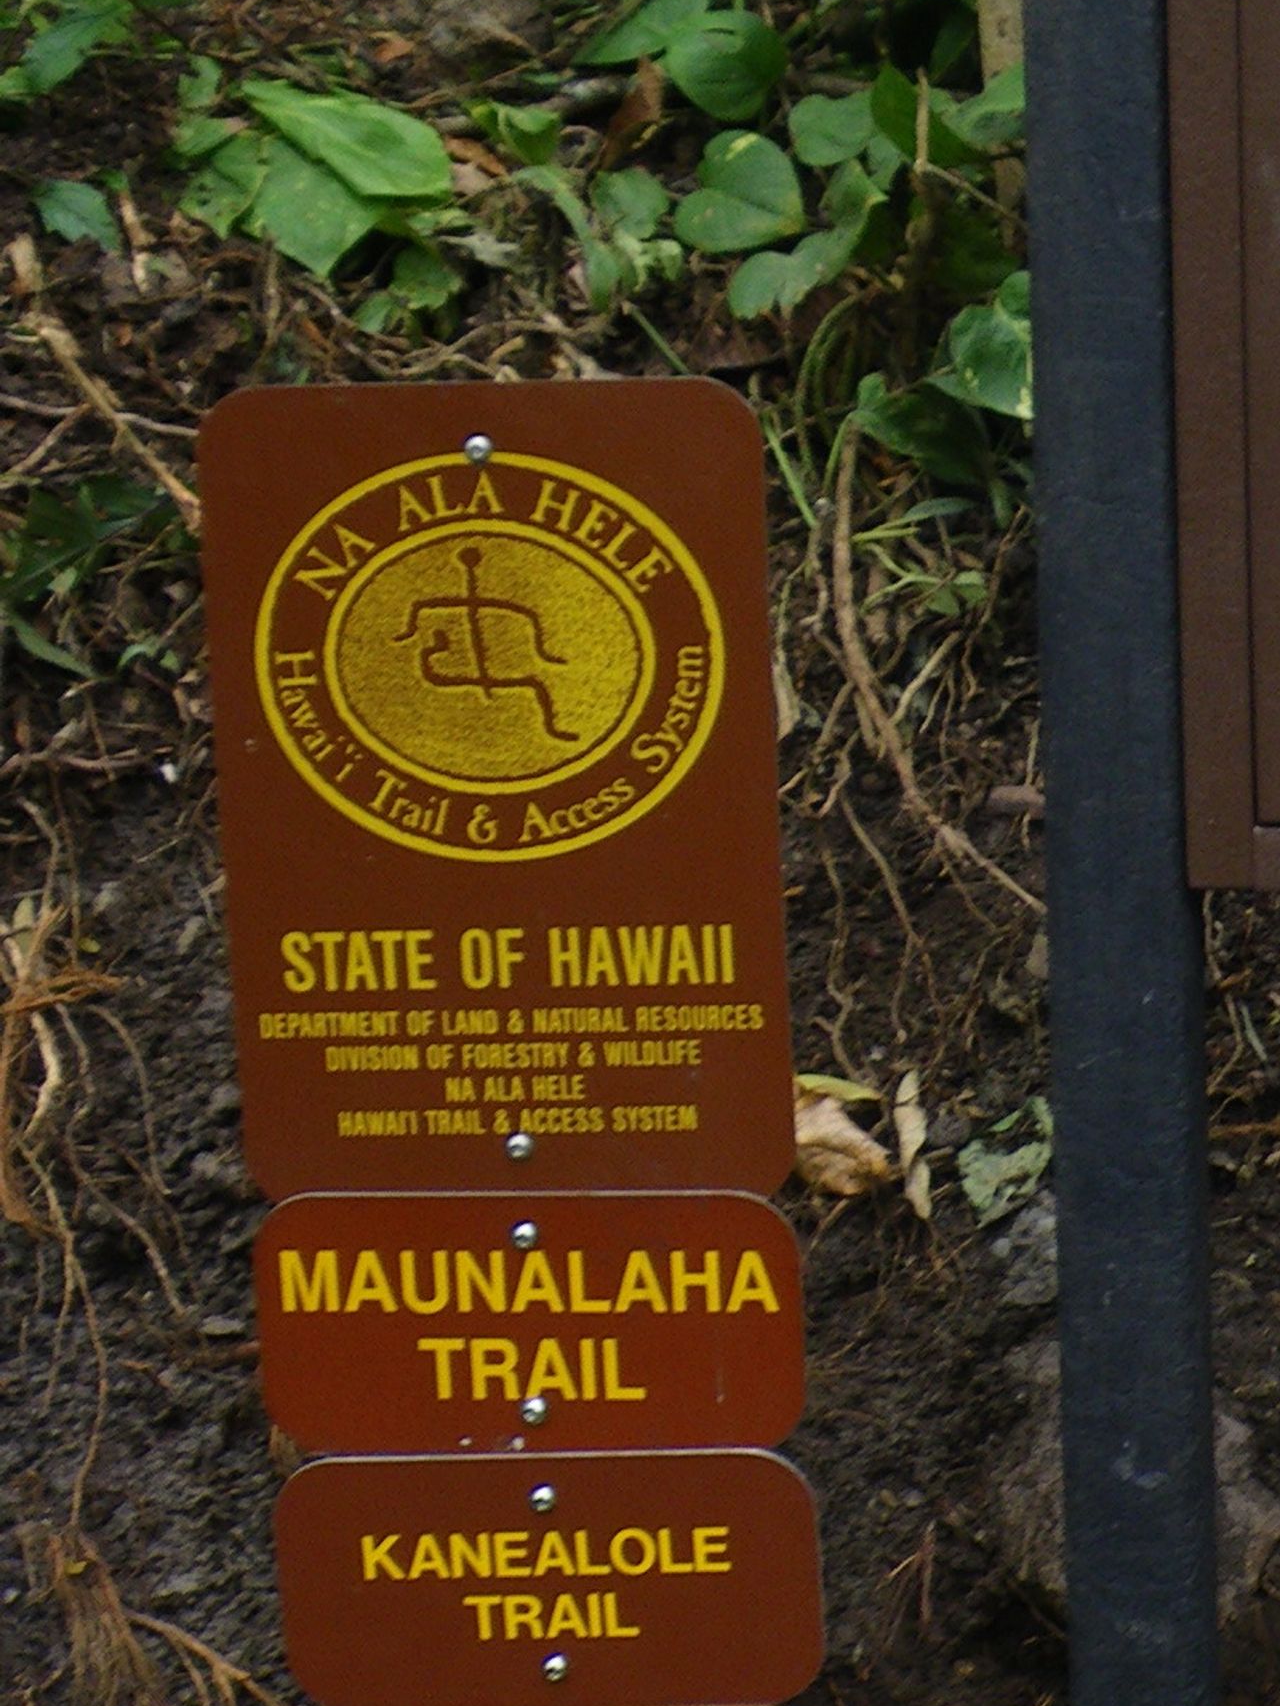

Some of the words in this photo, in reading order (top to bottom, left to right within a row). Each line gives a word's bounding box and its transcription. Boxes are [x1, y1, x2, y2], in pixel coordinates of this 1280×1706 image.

[295, 524, 376, 602] NA
[398, 472, 503, 532] ALA
[533, 480, 676, 596] HELE
[368, 768, 448, 838] Trail
[466, 803, 499, 844] &
[517, 775, 638, 844] Access
[629, 643, 706, 774] System
[280, 930, 438, 993] STATE
[459, 927, 526, 990] OF
[548, 924, 737, 989] HAWAII
[259, 1010, 398, 1040] DEPARTMENT
[406, 1009, 436, 1037] OF
[442, 1008, 499, 1036] LAND
[507, 1008, 524, 1036] &
[532, 1006, 630, 1035] NATURAL
[636, 1004, 765, 1033] RESOURCES
[325, 1045, 419, 1072] DIVISION
[427, 1044, 455, 1071] OF
[462, 1042, 569, 1070] FORESTRY
[578, 1041, 595, 1067] &
[603, 1039, 702, 1066] WILDLIFE
[445, 1076, 476, 1103] NA
[484, 1075, 526, 1102] ALA
[532, 1074, 587, 1101] HELE
[425, 1108, 487, 1136] TRAIL
[493, 1108, 511, 1135] &
[519, 1106, 605, 1134] ACCESS
[612, 1105, 699, 1132] SYSTEM
[277, 1249, 781, 1315] MAUNALAHA
[417, 1338, 648, 1402] TRAIL
[360, 1526, 733, 1581] KANEALOLE
[463, 1592, 642, 1641] TRAIL
